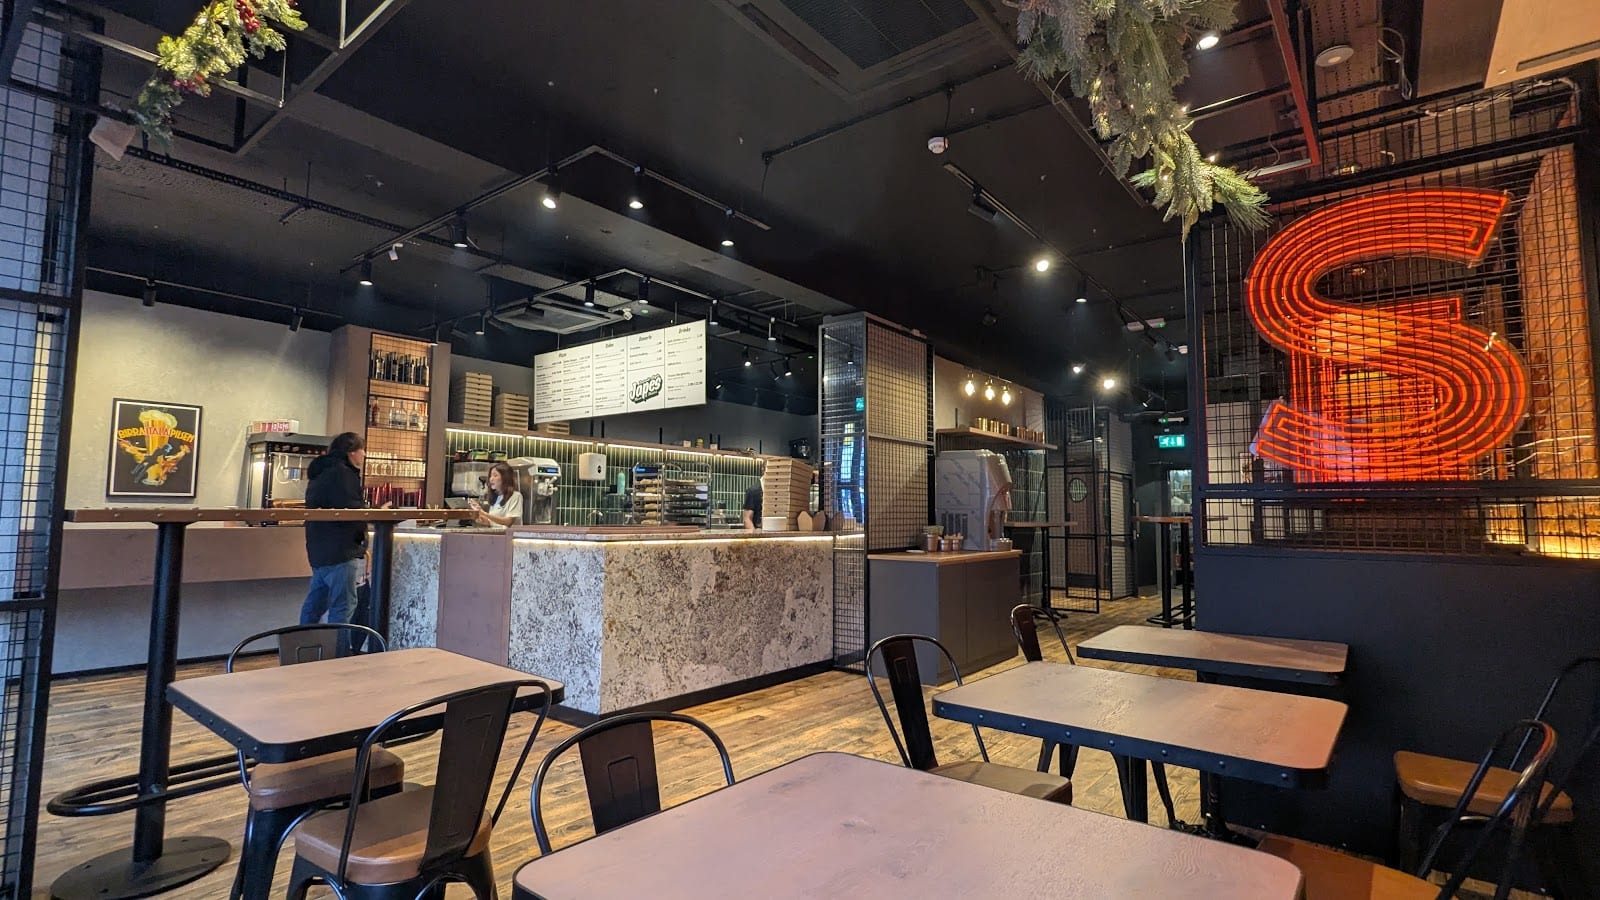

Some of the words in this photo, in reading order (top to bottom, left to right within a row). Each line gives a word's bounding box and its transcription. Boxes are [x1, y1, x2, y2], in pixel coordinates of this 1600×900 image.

[1247, 188, 1527, 477] S
[629, 376, 662, 401] Japes
[118, 426, 145, 439] BIRRA
[170, 428, 195, 443] PILSEN
